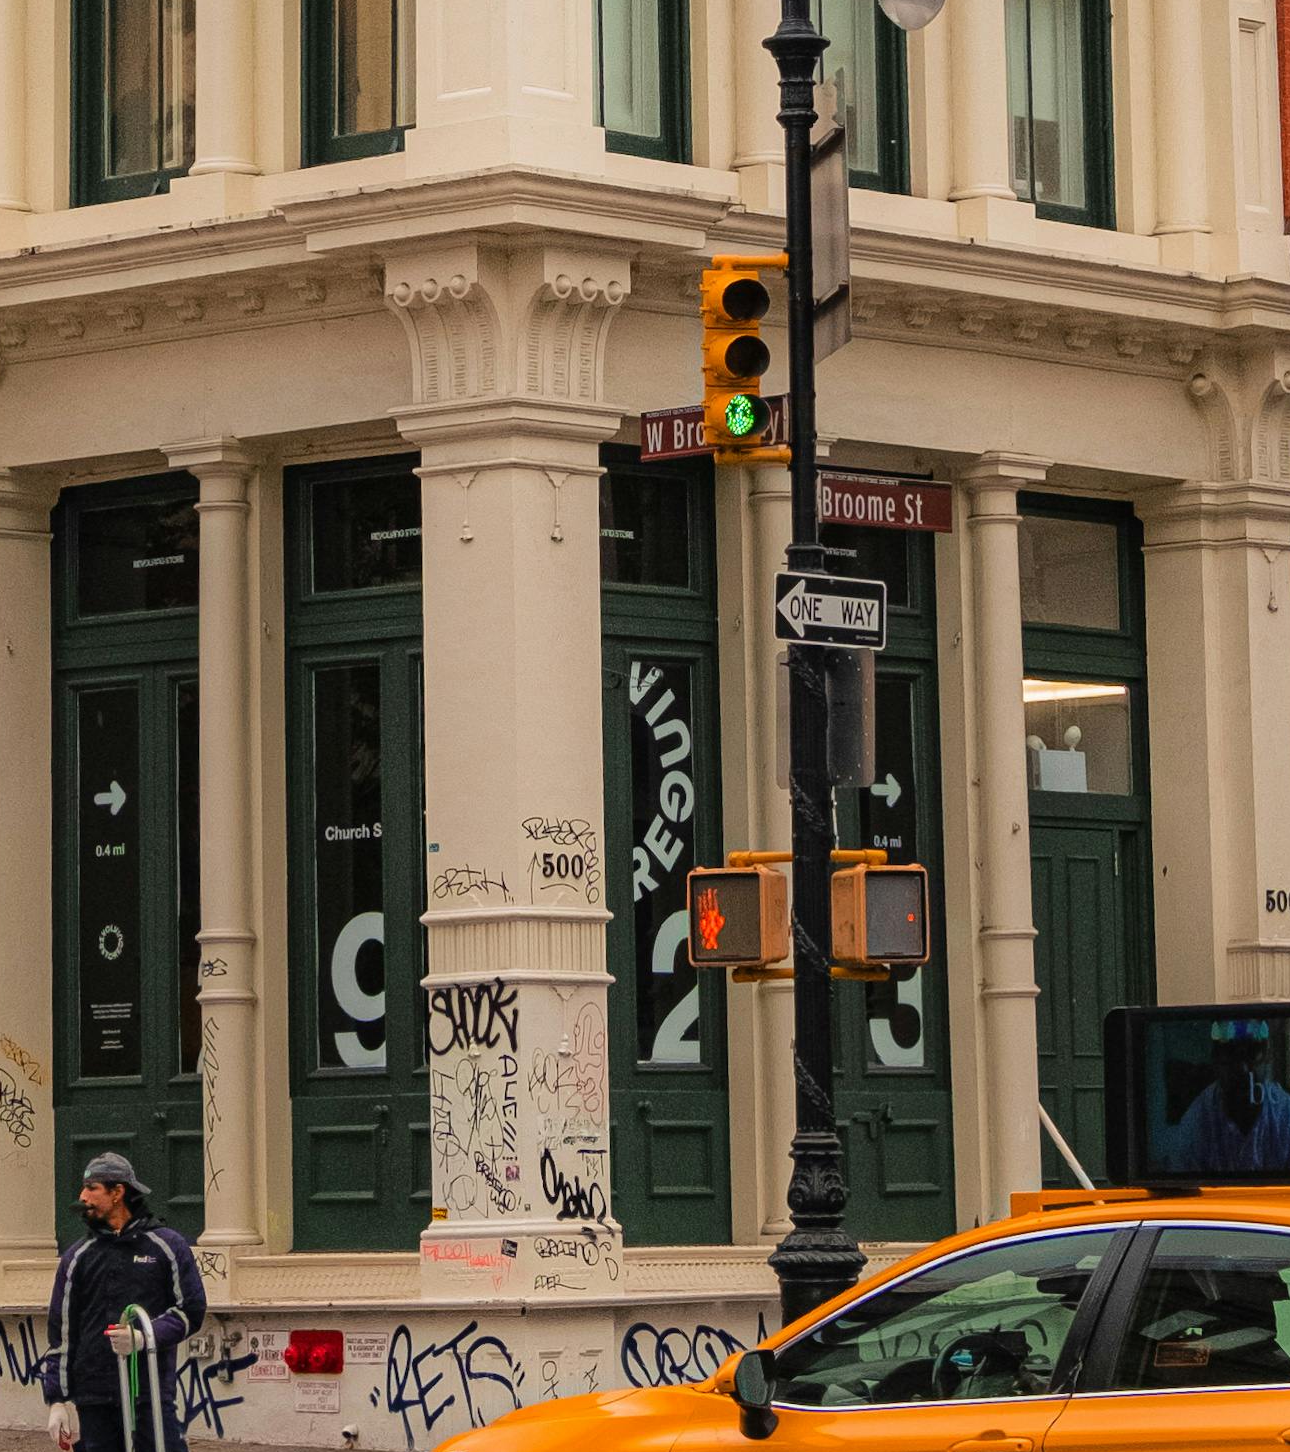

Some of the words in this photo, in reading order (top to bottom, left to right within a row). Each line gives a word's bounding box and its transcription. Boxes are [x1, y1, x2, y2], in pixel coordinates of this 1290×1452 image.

[646, 422, 664, 453] W
[822, 486, 896, 522] Broome
[904, 493, 923, 525] St
[790, 596, 822, 622] ONE
[841, 600, 875, 627] WAY
[325, 823, 370, 841] Church
[874, 835, 888, 848] 0.4
[889, 835, 902, 849] mi
[96, 844, 111, 857] 0.4
[112, 843, 125, 856] mi
[542, 853, 584, 879] 500
